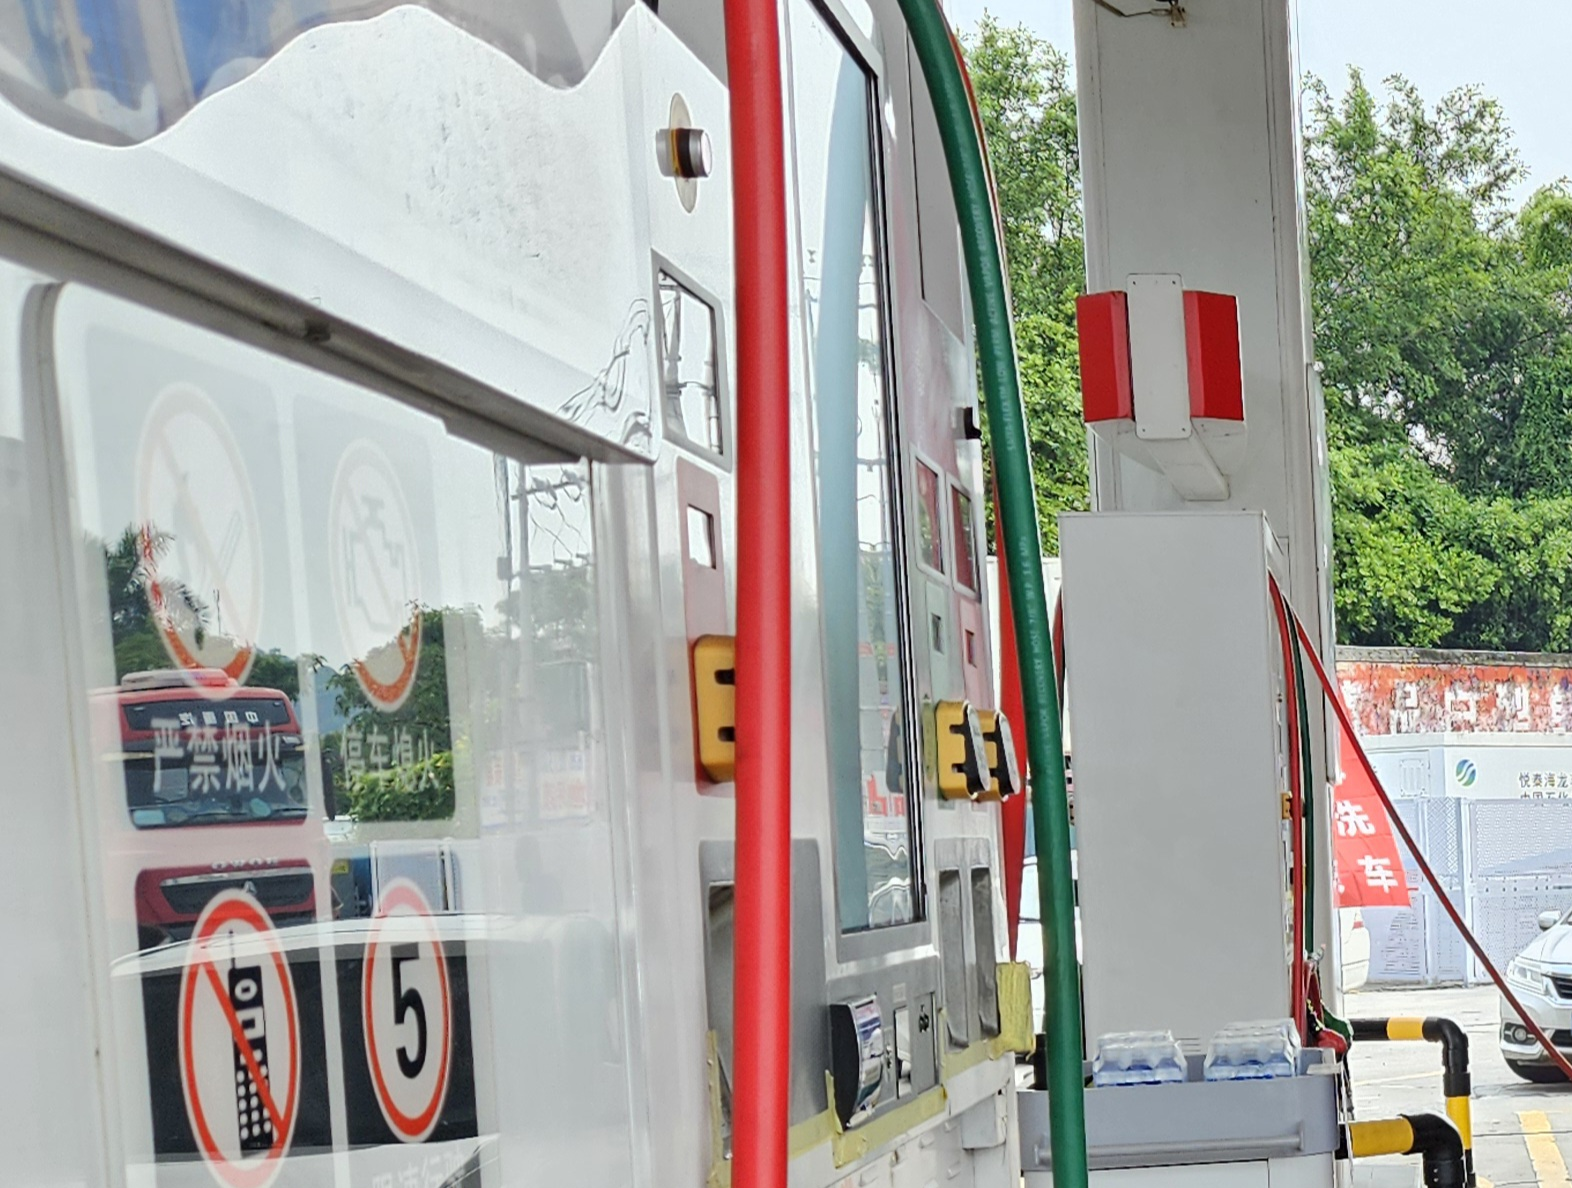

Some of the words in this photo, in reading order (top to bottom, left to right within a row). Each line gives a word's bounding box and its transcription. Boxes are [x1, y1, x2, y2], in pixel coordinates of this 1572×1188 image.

[151, 718, 287, 794] 严禁烟火
[340, 723, 439, 793] 停车熄火
[391, 943, 427, 1079] 5
